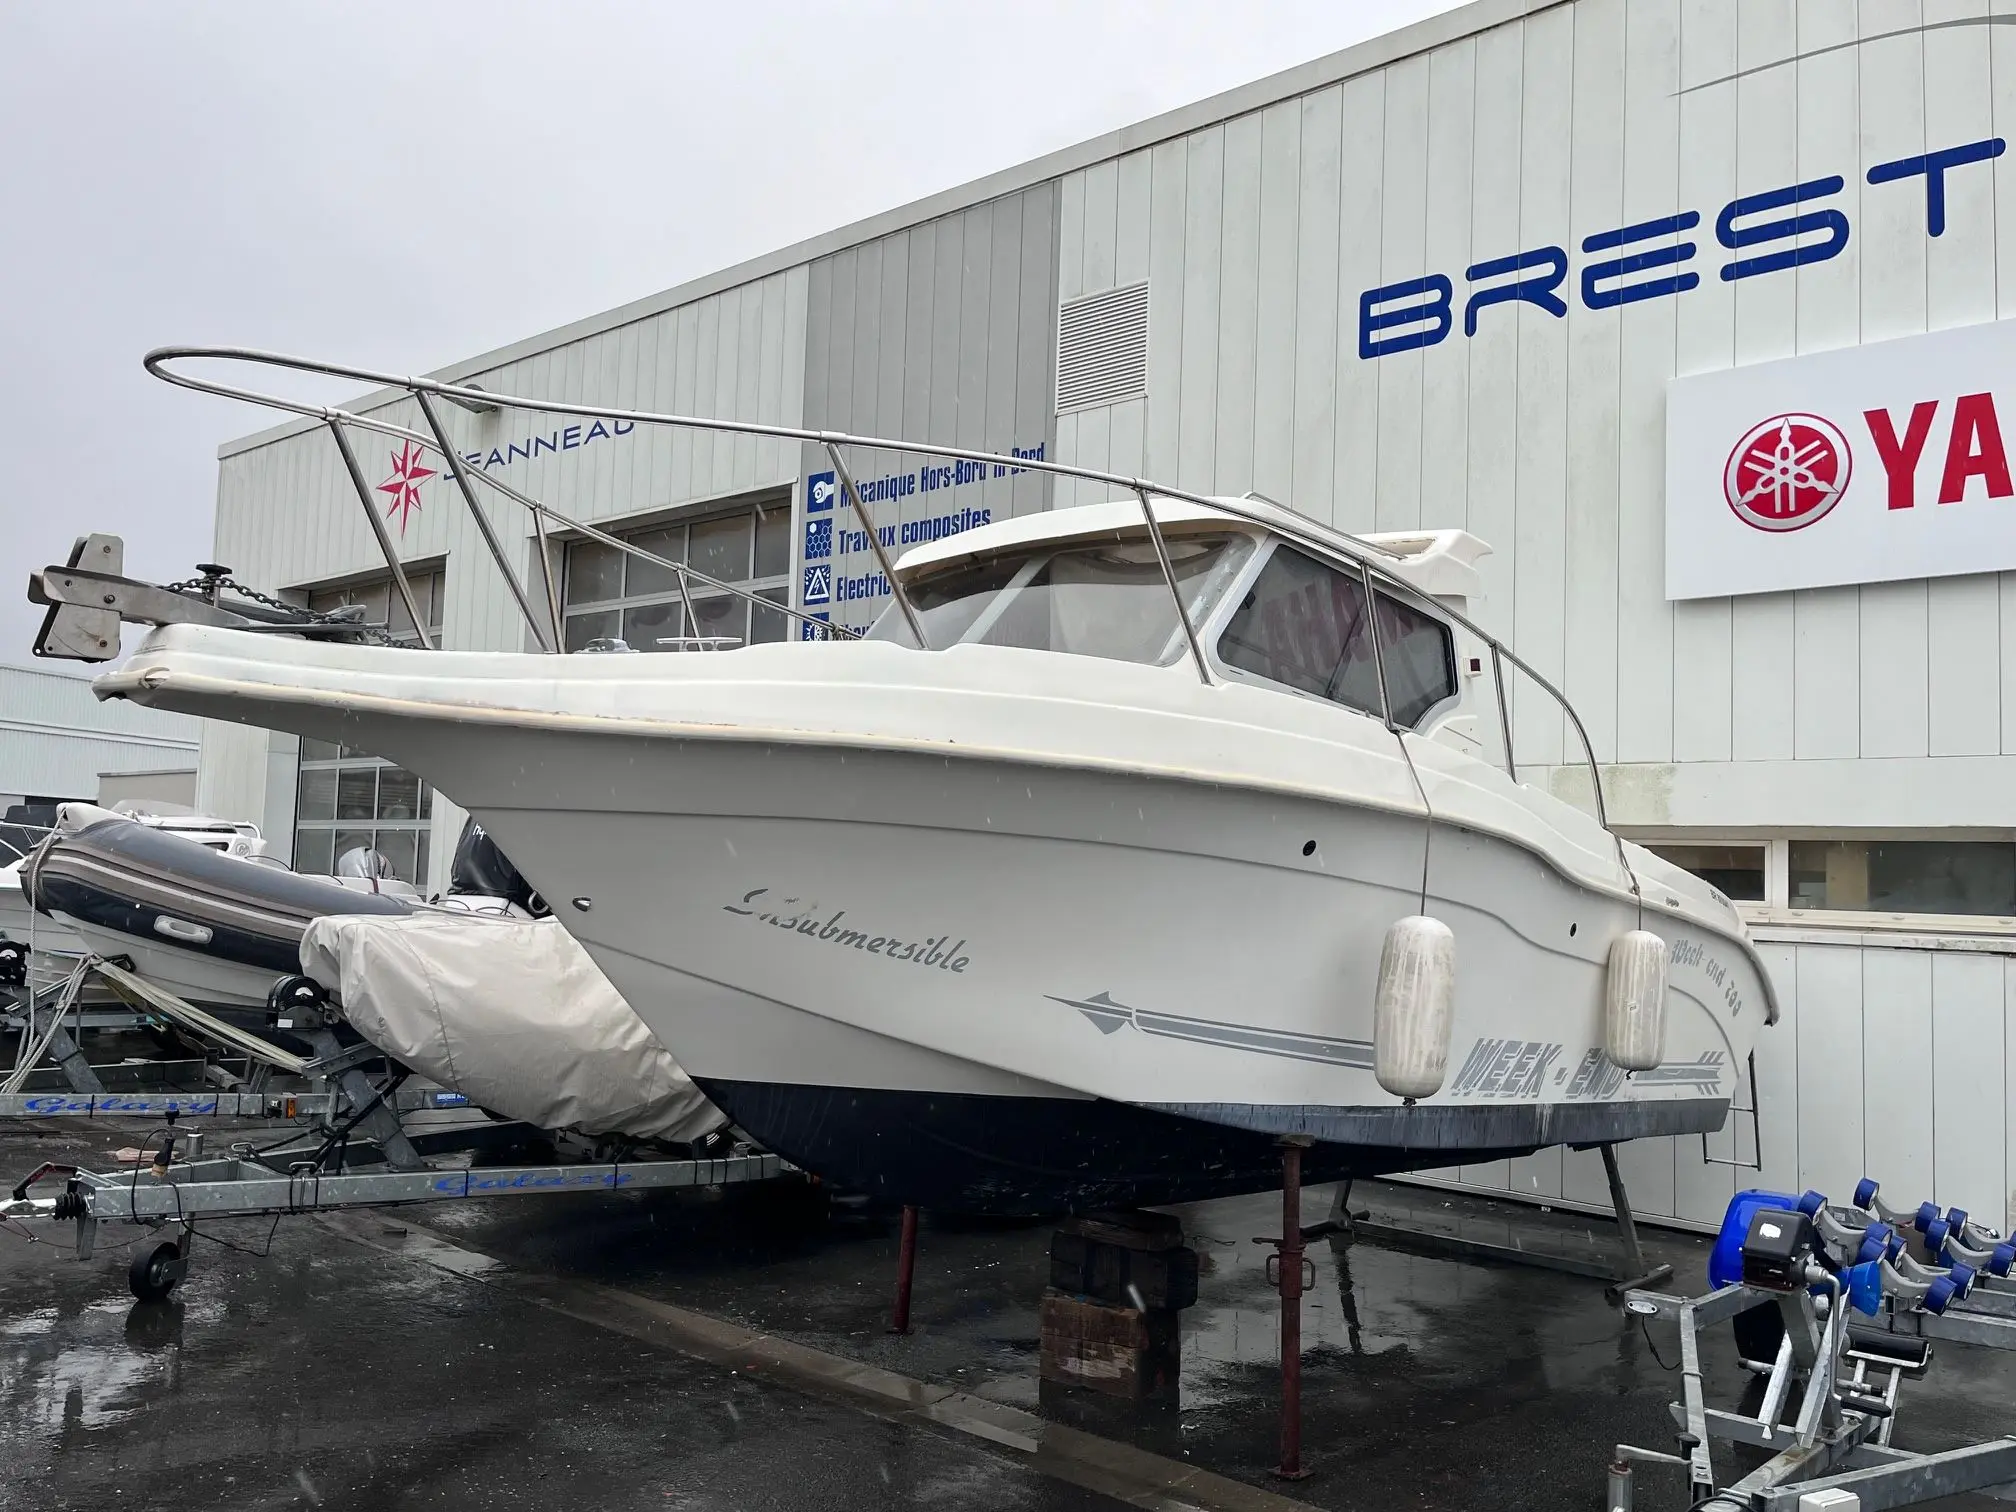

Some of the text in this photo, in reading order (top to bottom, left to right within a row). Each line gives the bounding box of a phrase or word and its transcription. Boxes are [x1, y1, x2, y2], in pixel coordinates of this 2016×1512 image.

[1358, 137, 2006, 359] BREST
[1863, 391, 2015, 511] YA
[838, 507, 991, 555] Travux composites
[25, 1096, 217, 1114] Galaxy
[433, 1172, 634, 1196] Galaxy
